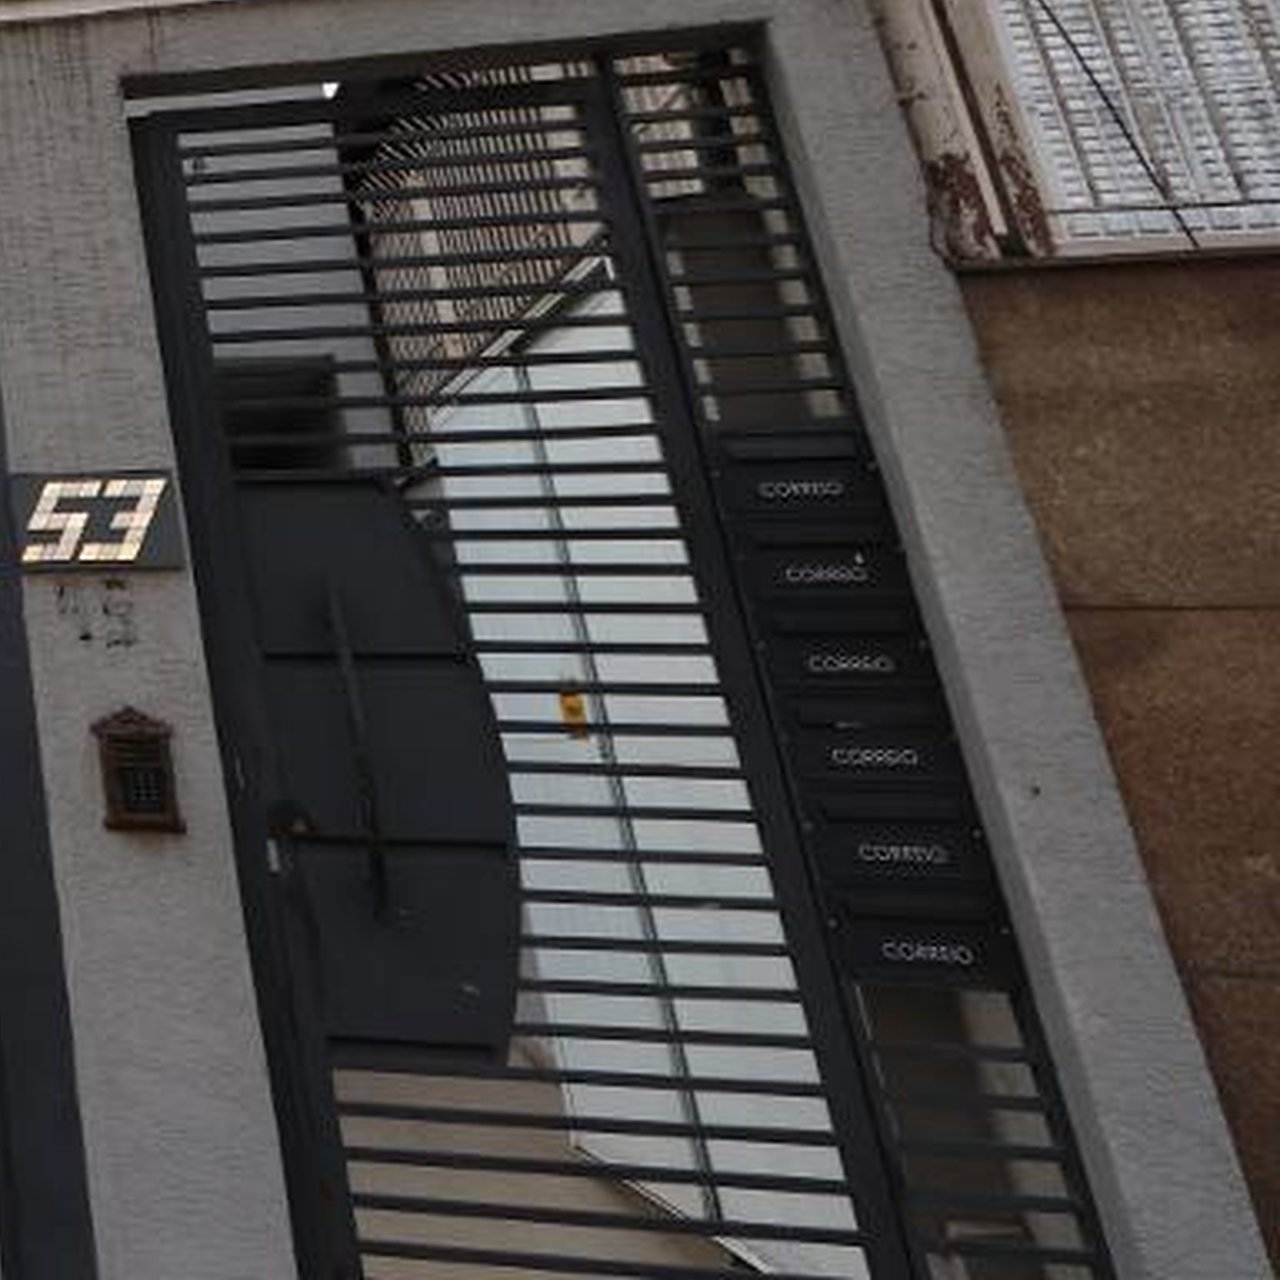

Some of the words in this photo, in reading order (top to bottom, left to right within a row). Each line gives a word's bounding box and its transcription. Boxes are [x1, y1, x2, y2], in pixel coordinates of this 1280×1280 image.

[758, 481, 845, 499] CORREIO
[21, 478, 168, 561] 53
[785, 565, 869, 583] CORREIO
[808, 654, 896, 673] CORREIO
[832, 748, 919, 766] CORREIO
[858, 842, 949, 864] CORREIO
[881, 941, 974, 965] CORREIO
